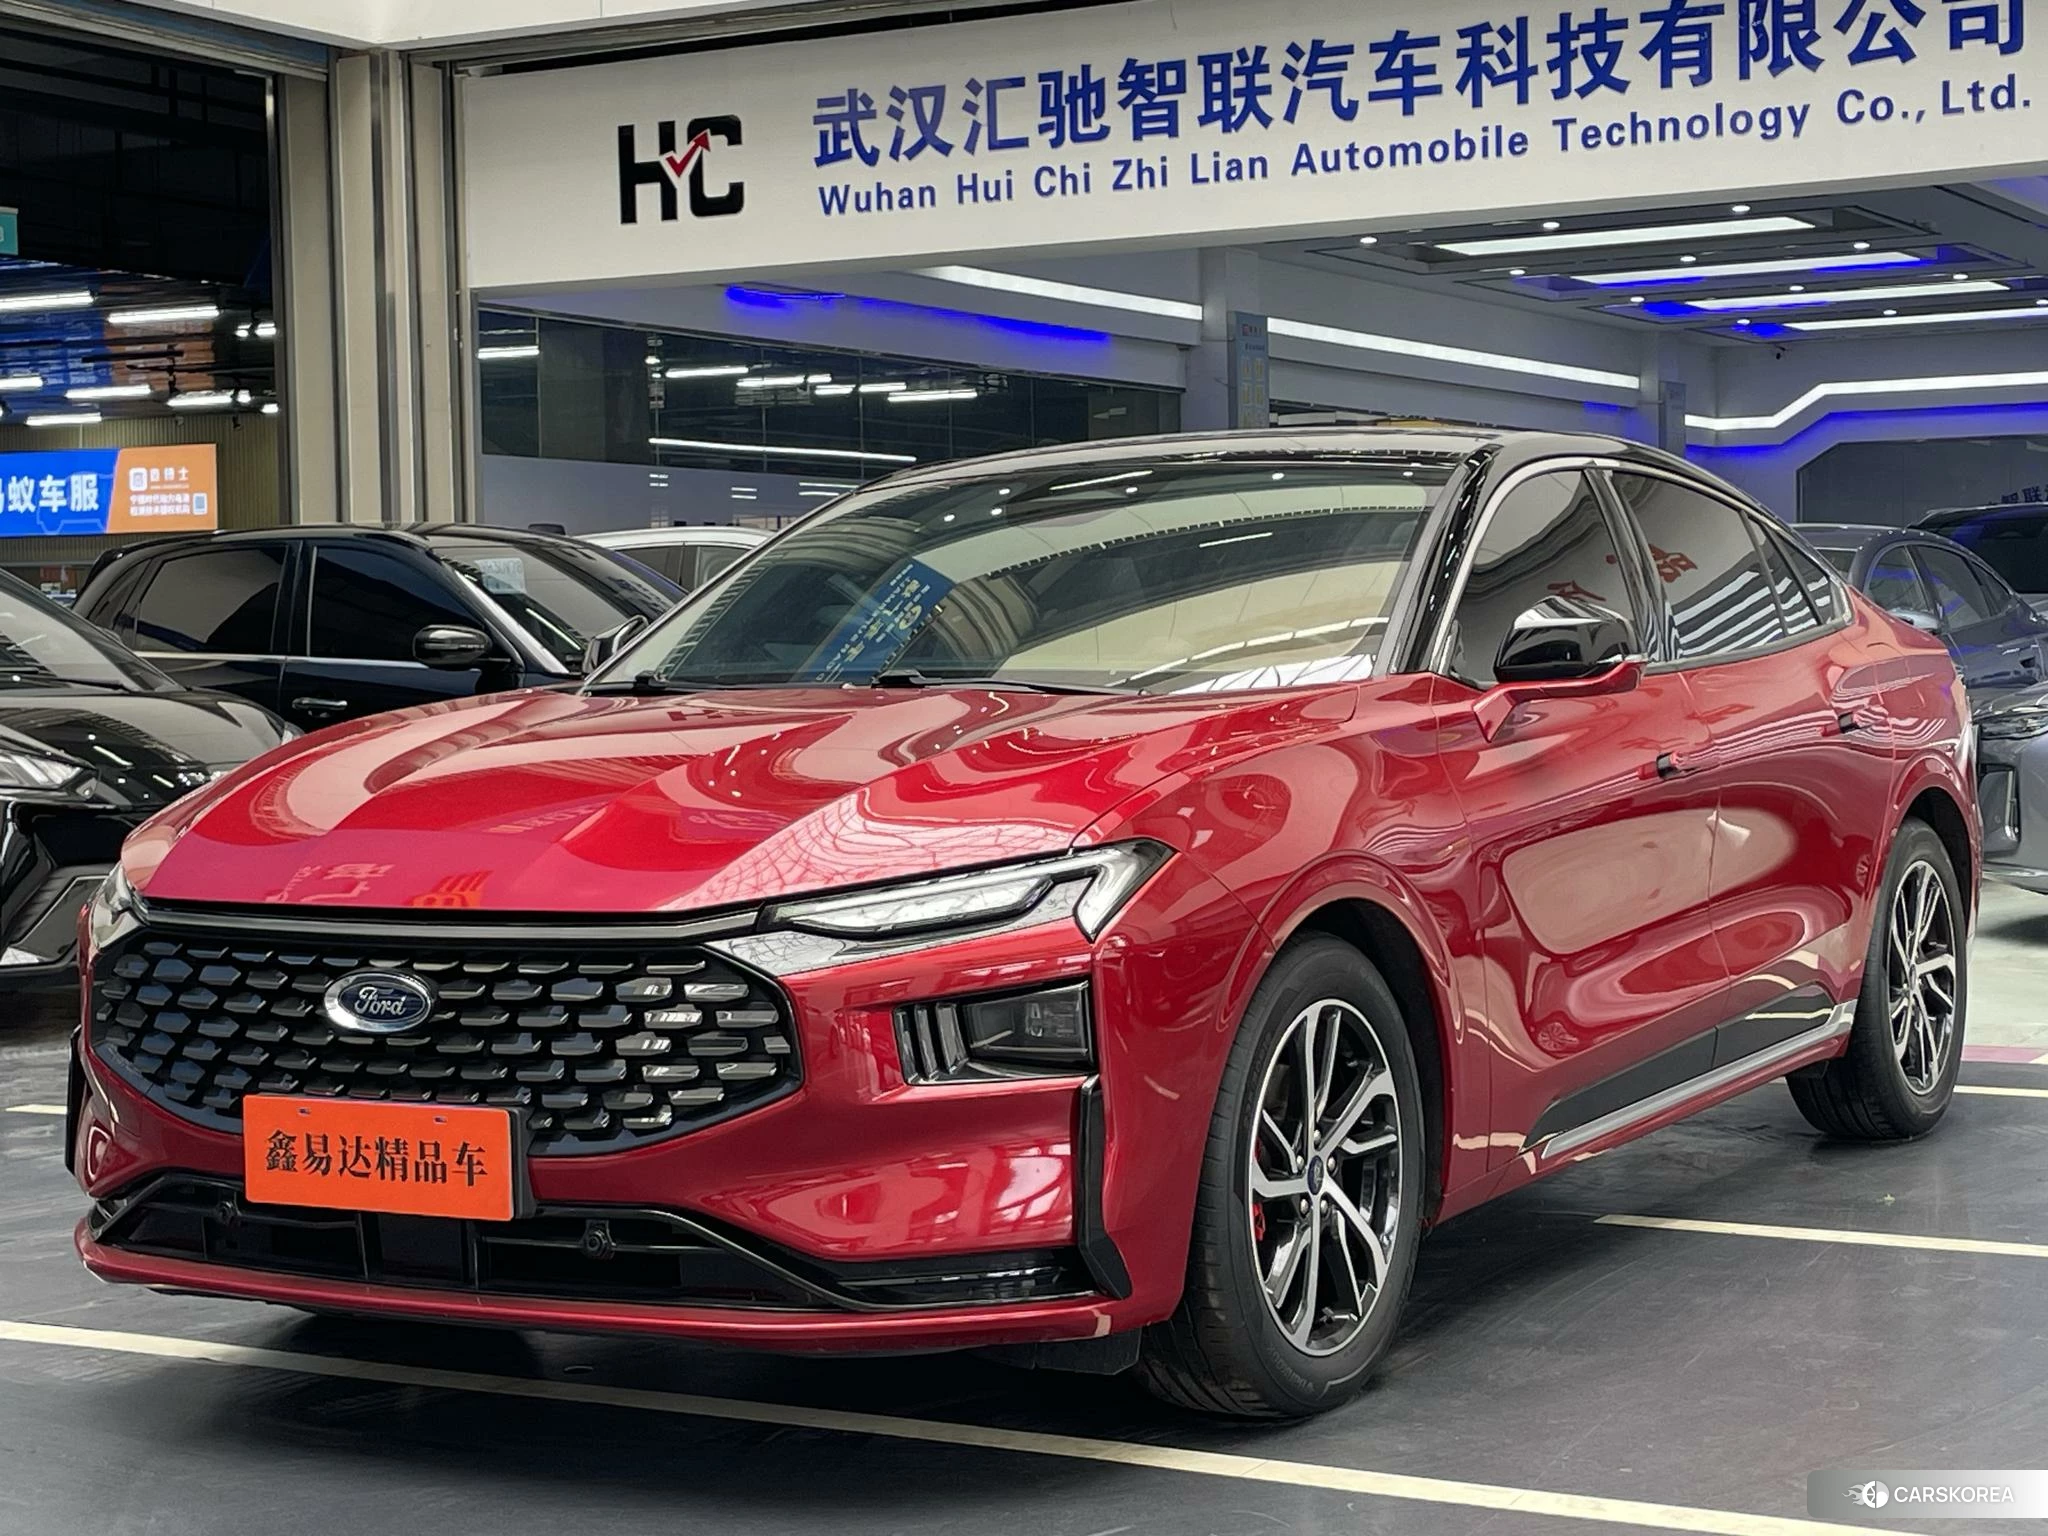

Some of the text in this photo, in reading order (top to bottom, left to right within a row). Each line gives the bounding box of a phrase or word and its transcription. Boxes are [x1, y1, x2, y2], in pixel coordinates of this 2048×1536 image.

[813, 0, 2025, 169] 武汉汇驰智联汽车科技有限公司
[818, 73, 2031, 216] Wuhan Hui Chi Zhi Lian Automobile Technology Co., Ltd.
[0, 474, 99, 514] 蚁车服
[354, 985, 407, 1016] Ford
[264, 1129, 488, 1187] 鑫易达精品车
